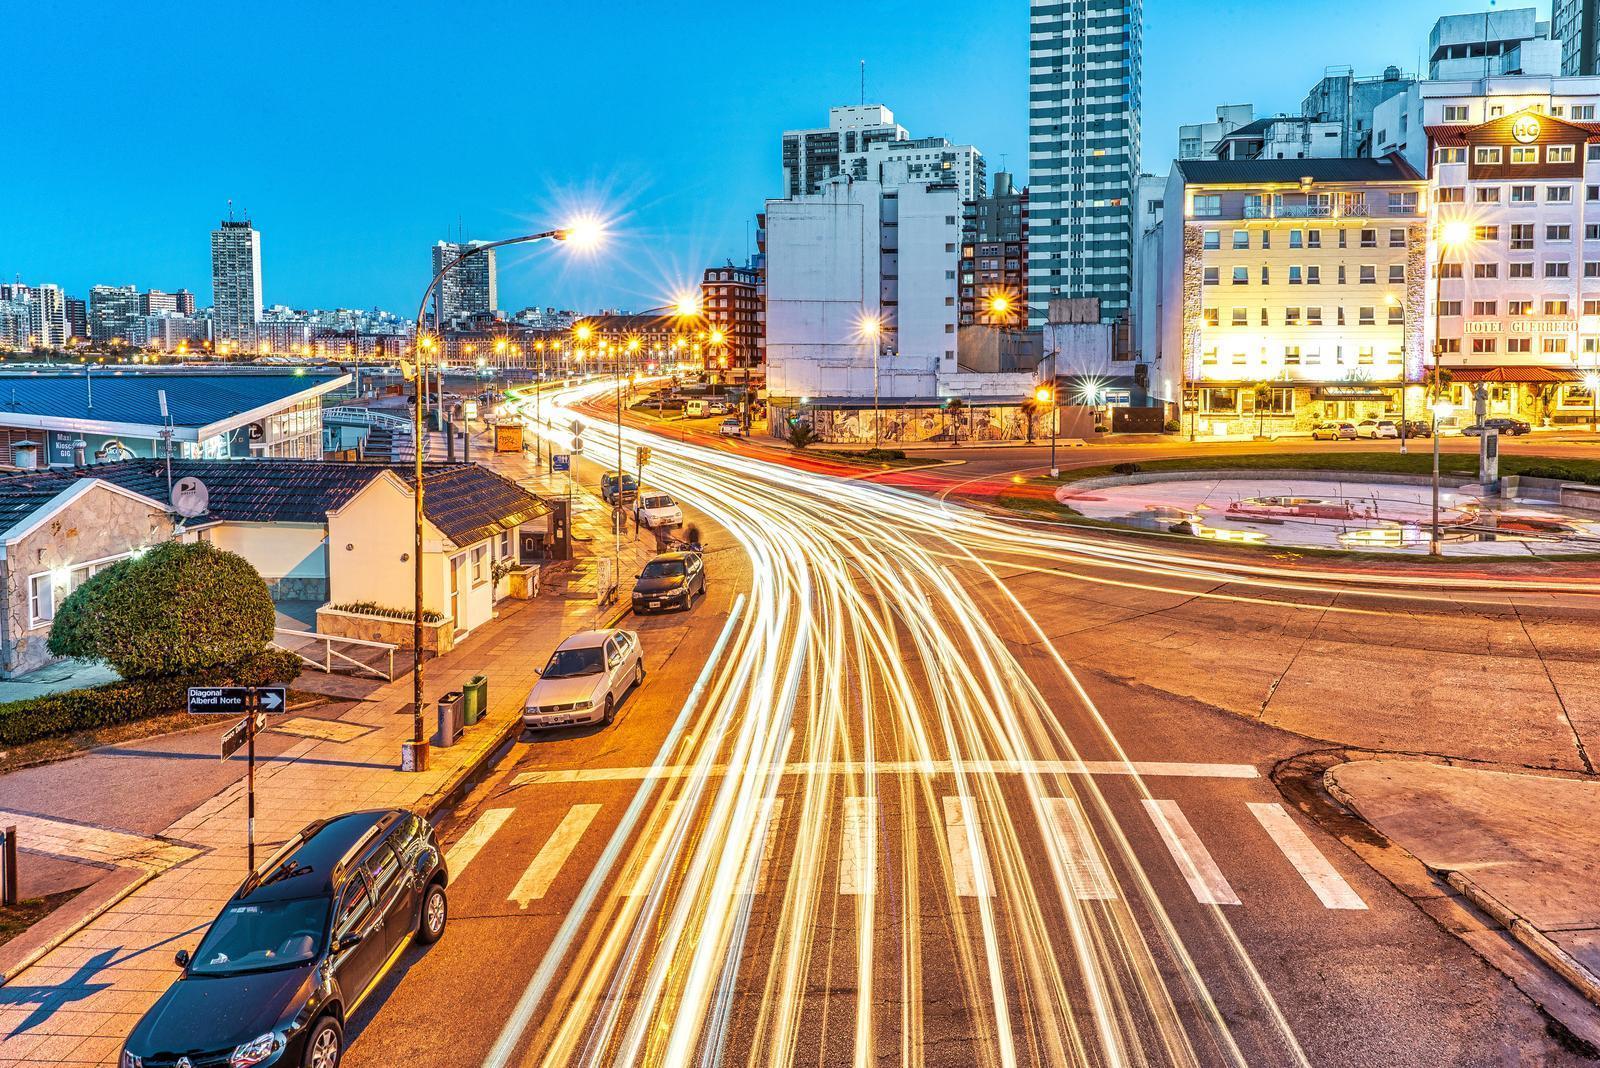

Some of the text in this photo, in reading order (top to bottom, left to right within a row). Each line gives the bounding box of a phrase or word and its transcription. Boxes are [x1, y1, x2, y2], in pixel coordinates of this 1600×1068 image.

[1515, 124, 1538, 136] HG
[1465, 322, 1578, 332] HOTEL GUERRERO
